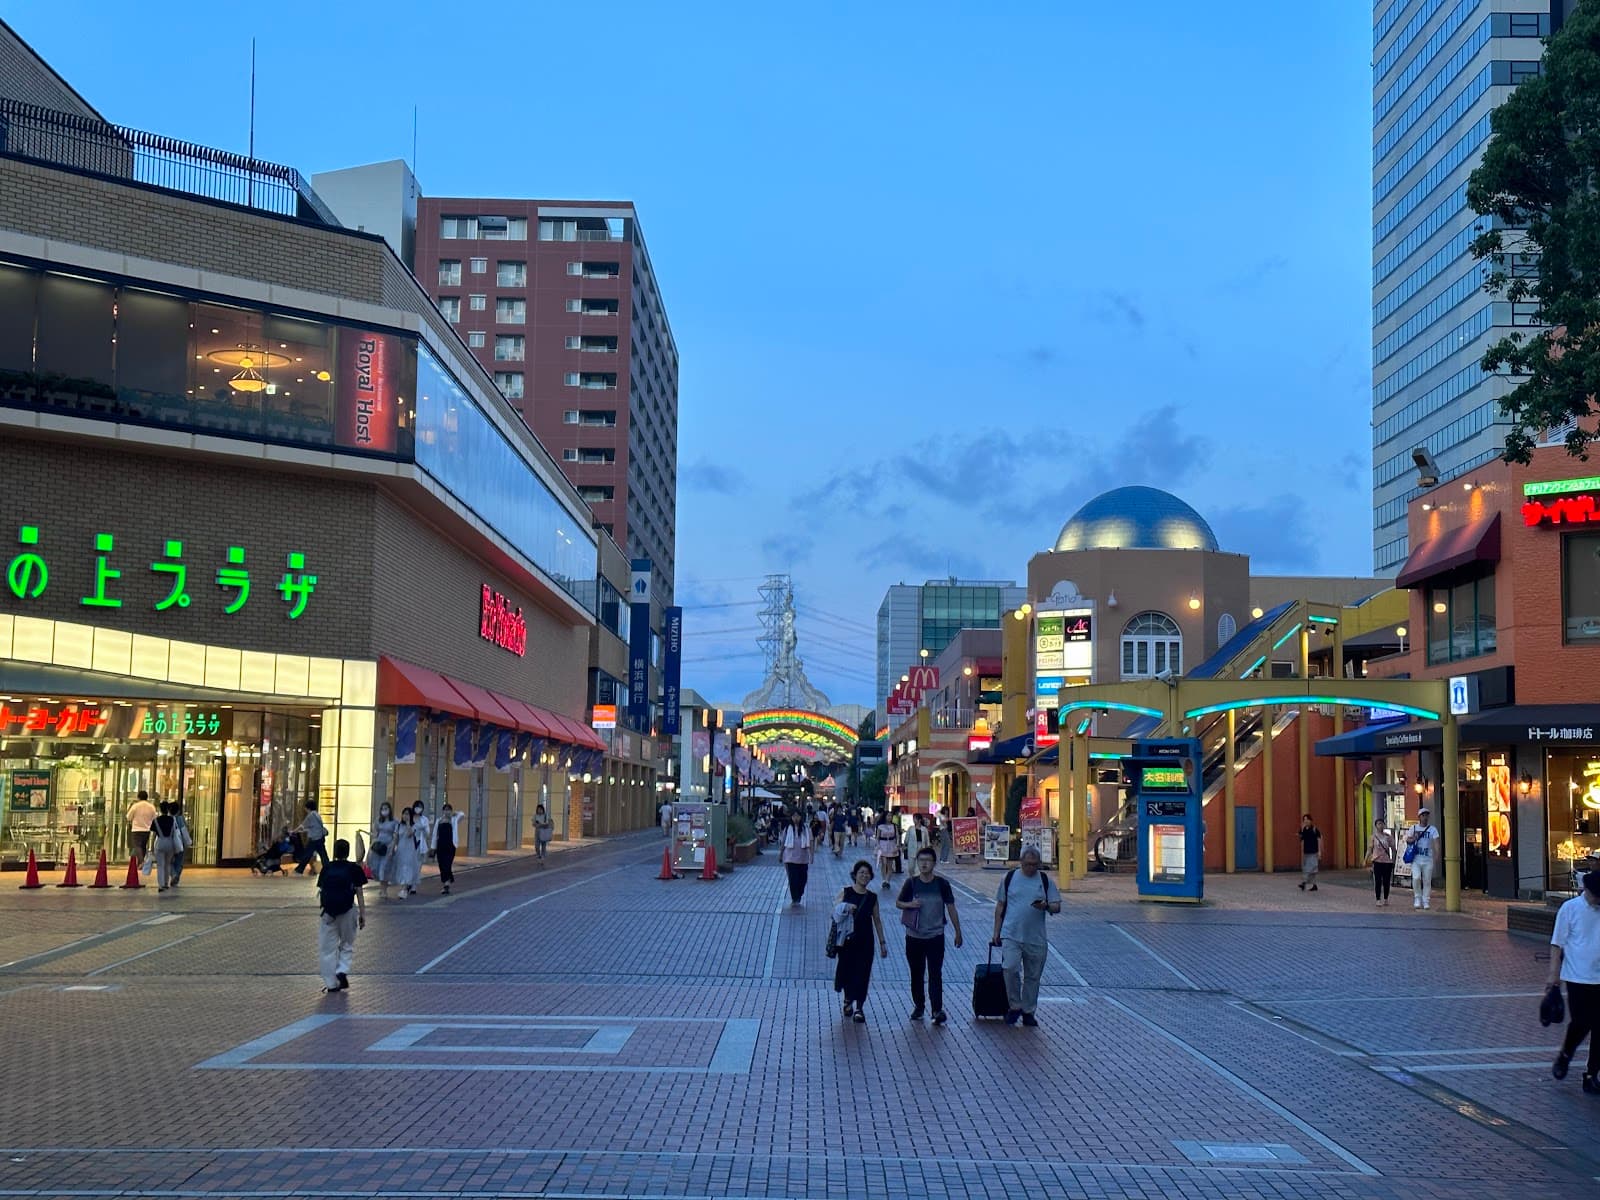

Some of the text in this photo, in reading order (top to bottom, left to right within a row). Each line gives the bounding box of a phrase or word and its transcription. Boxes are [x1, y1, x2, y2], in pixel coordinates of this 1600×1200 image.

[355, 339, 375, 443] Royal Host
[671, 616, 680, 653] MIZUHO
[633, 658, 645, 704] 横浜銀行
[142, 718, 221, 736] 丘の上プラザ
[1528, 727, 1593, 739] ドトール珈琲店
